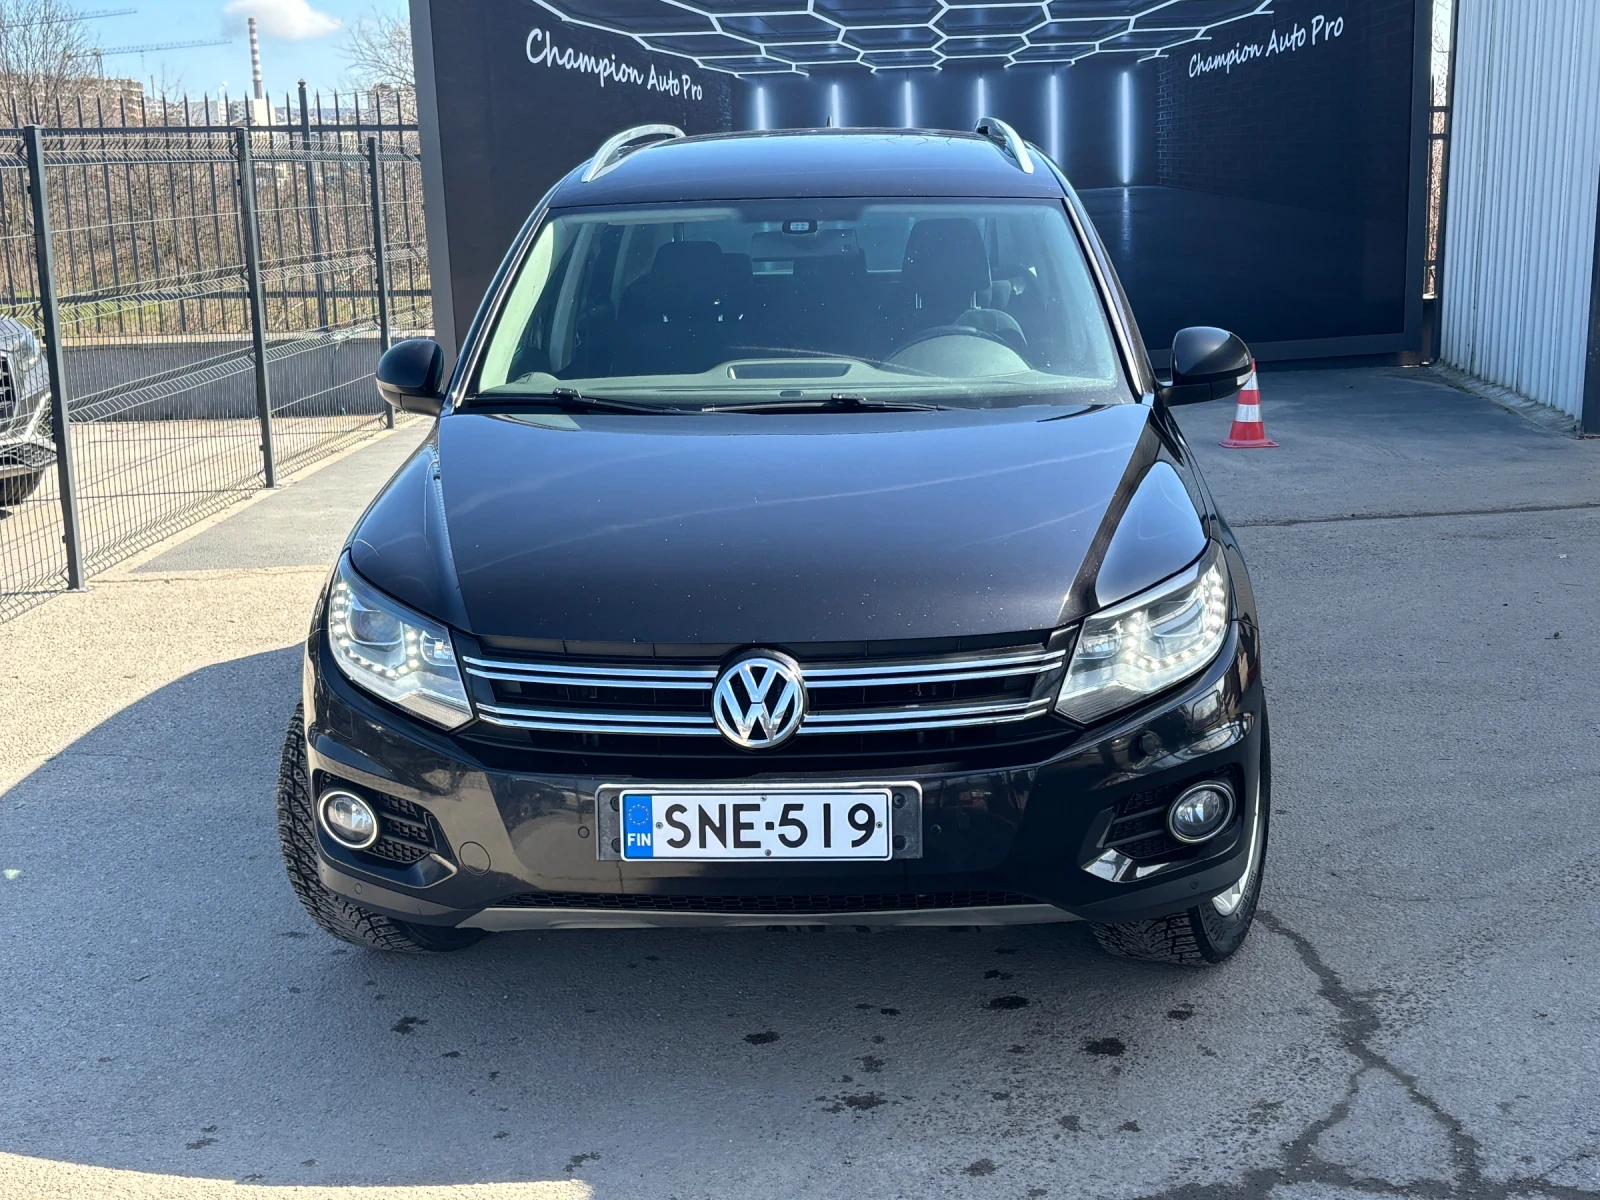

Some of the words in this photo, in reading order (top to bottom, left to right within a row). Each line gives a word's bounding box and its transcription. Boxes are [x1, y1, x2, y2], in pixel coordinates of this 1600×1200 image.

[526, 28, 644, 87] Champion
[647, 64, 680, 96] Auto
[681, 74, 702, 100] Pro
[1188, 42, 1264, 78] Champion
[1265, 23, 1306, 57] Auto
[1311, 15, 1344, 45] Pro
[627, 833, 651, 847] FIN
[664, 802, 876, 849] SNE-519
